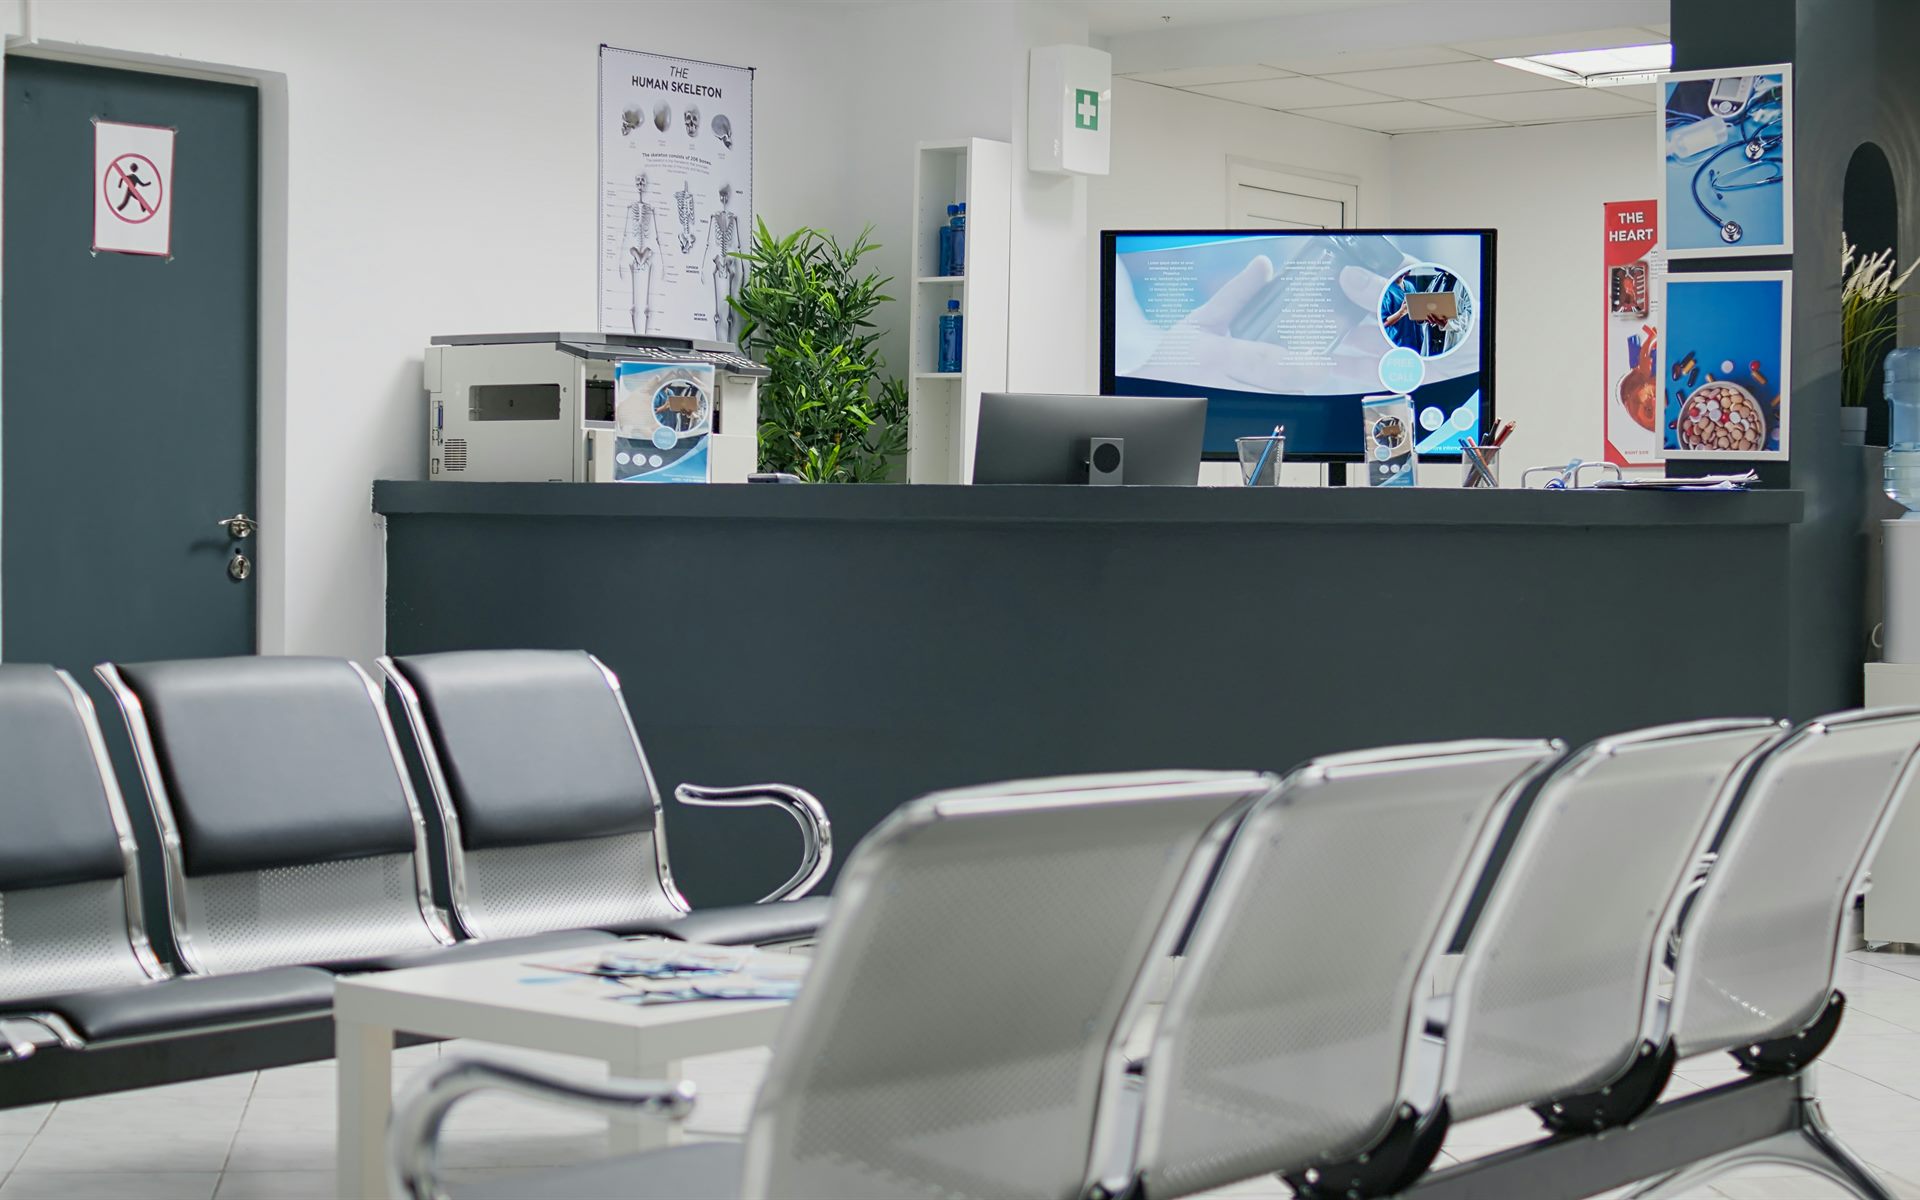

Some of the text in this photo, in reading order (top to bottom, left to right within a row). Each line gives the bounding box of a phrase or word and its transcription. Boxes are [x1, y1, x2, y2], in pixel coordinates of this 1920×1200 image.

[670, 65, 689, 79] THE
[632, 75, 722, 99] HUMAN SKELETON
[1618, 212, 1645, 224] THE
[1609, 229, 1654, 242] HEART
[1387, 358, 1416, 368] FREE
[1389, 371, 1416, 381] CALL
